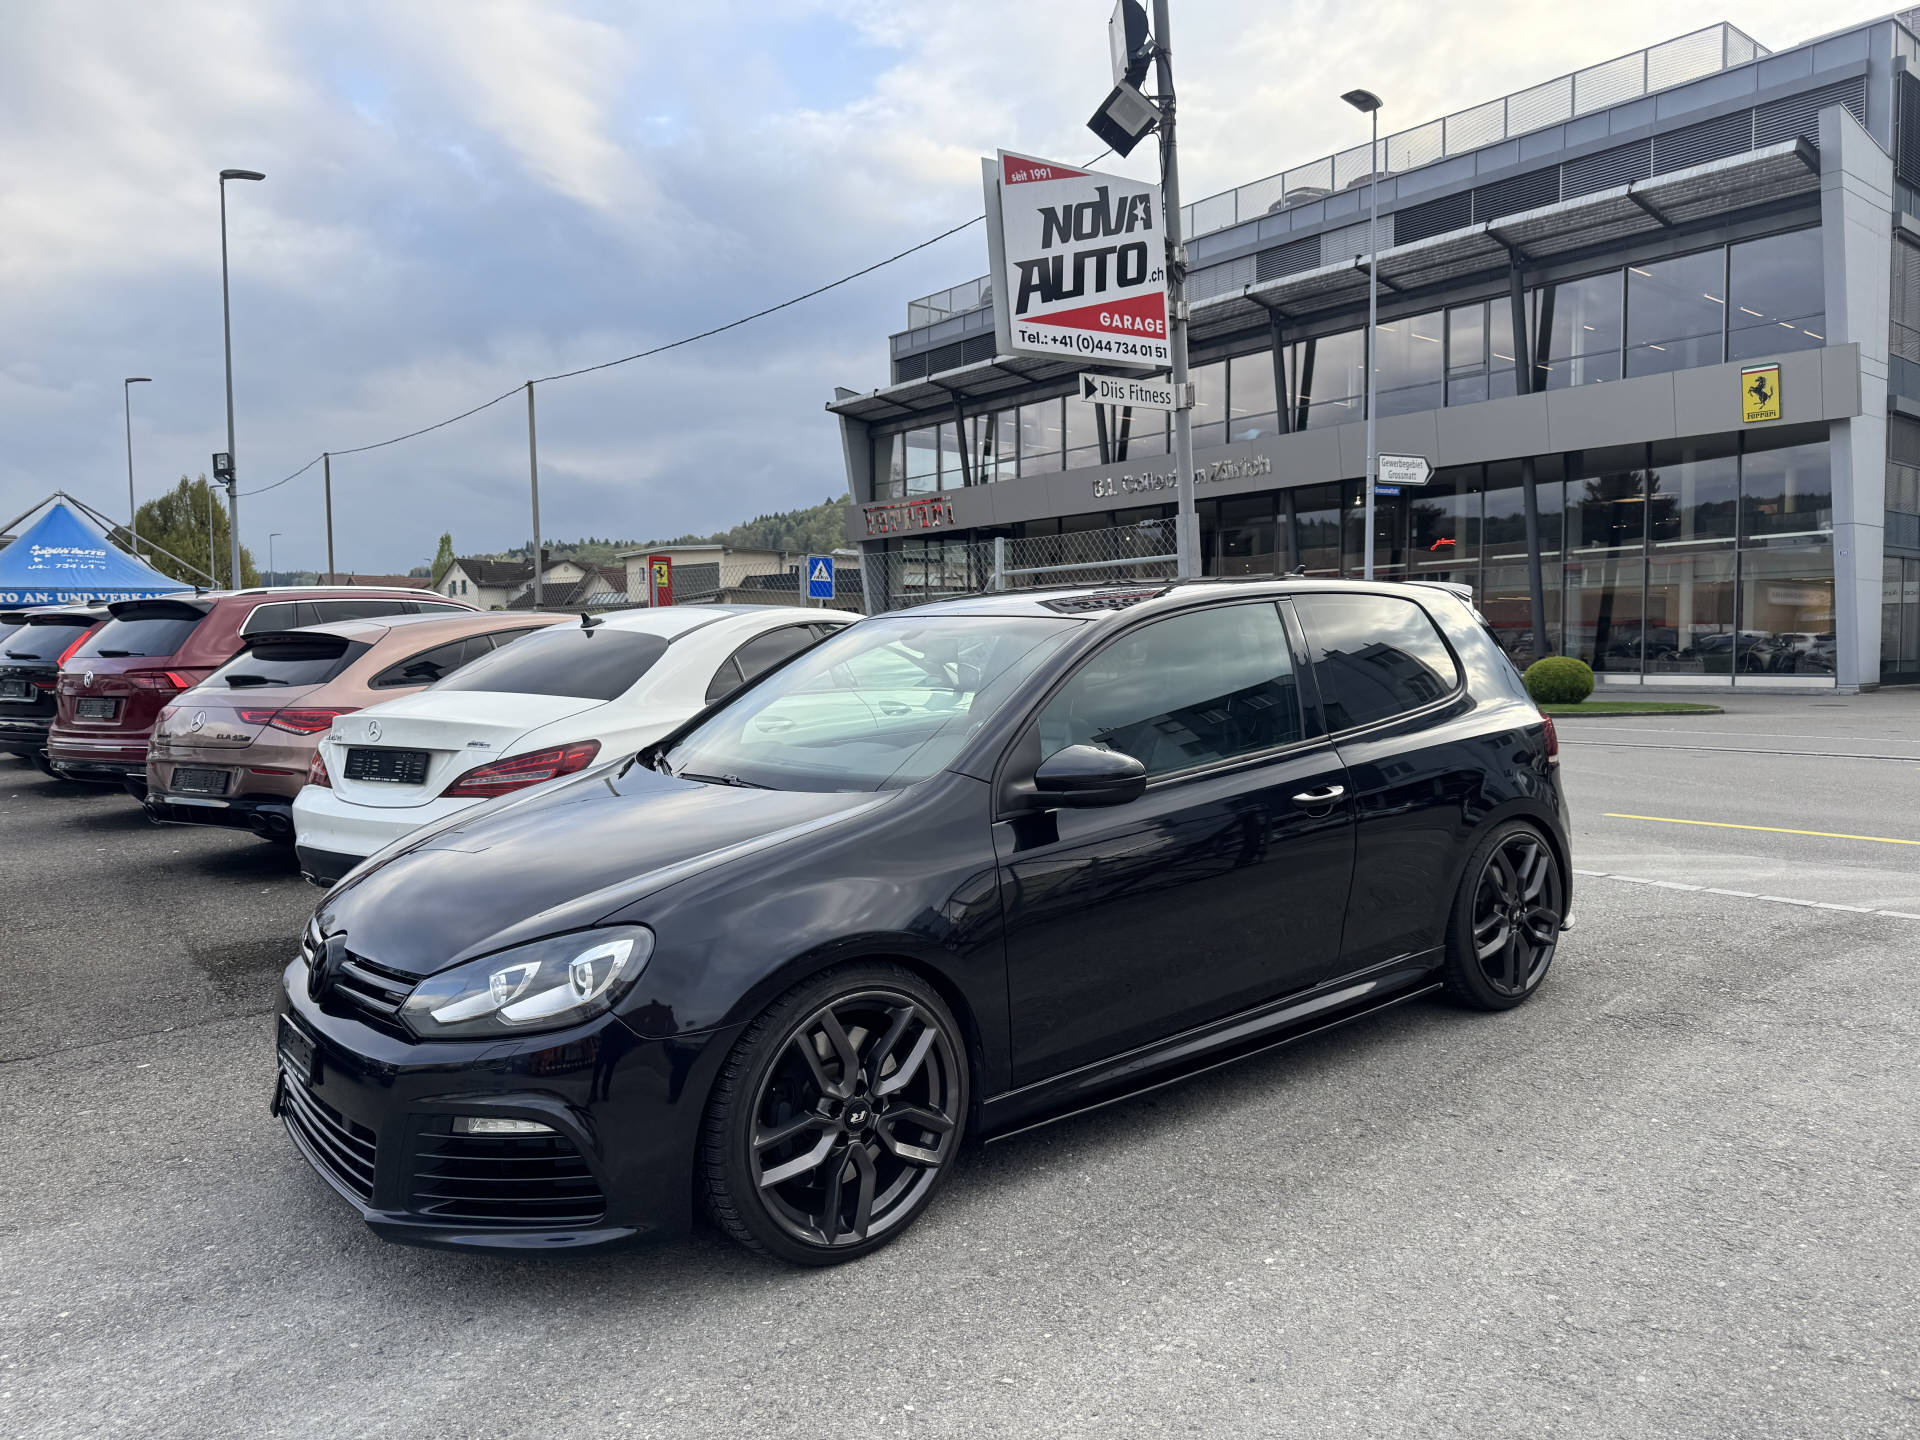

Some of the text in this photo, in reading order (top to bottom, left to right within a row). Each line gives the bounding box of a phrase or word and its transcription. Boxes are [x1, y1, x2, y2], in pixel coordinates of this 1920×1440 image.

[1011, 167, 1052, 182] seit 1991
[1036, 186, 1153, 249] NOVA
[1099, 311, 1164, 334] GARAGE
[1019, 330, 1049, 345] Tel.:
[1051, 335, 1073, 348] +41
[1115, 342, 1138, 356] 734
[1140, 345, 1153, 358] 01
[1155, 346, 1167, 359] 51
[1101, 380, 1171, 405] Diis Fitness
[1747, 410, 1776, 419] Ferrari
[1210, 453, 1272, 482] Zürich
[1381, 458, 1423, 471] Gewerbegebiet
[1387, 470, 1417, 480] Grossmatt
[22, 592, 54, 603] AN-
